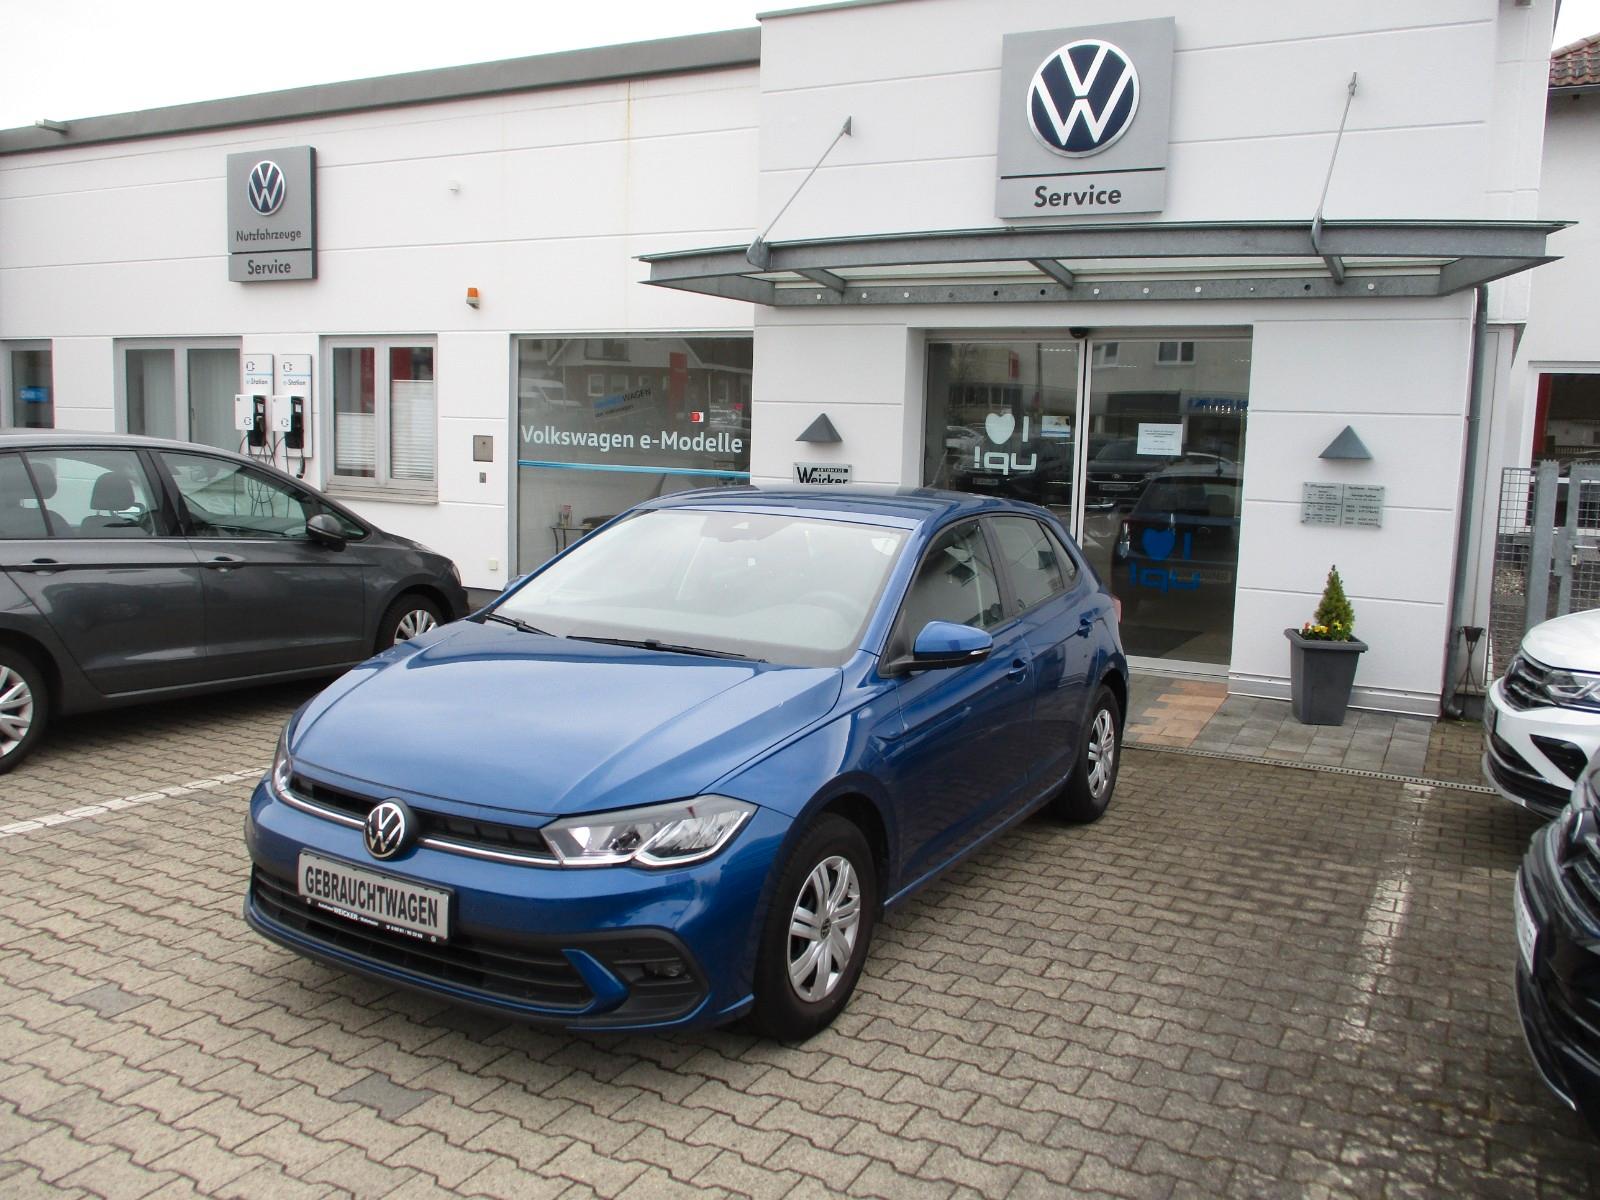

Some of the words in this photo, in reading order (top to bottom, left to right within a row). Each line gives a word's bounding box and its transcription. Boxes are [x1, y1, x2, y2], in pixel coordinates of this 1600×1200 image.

[1034, 184, 1122, 207] Service
[236, 228, 302, 242] Nutzfahrzeuge
[247, 259, 292, 275] Service
[521, 425, 634, 452] Volkswagen
[639, 430, 743, 453] e-Modelle
[306, 866, 438, 928] GEBRAUCHTWAGEN
